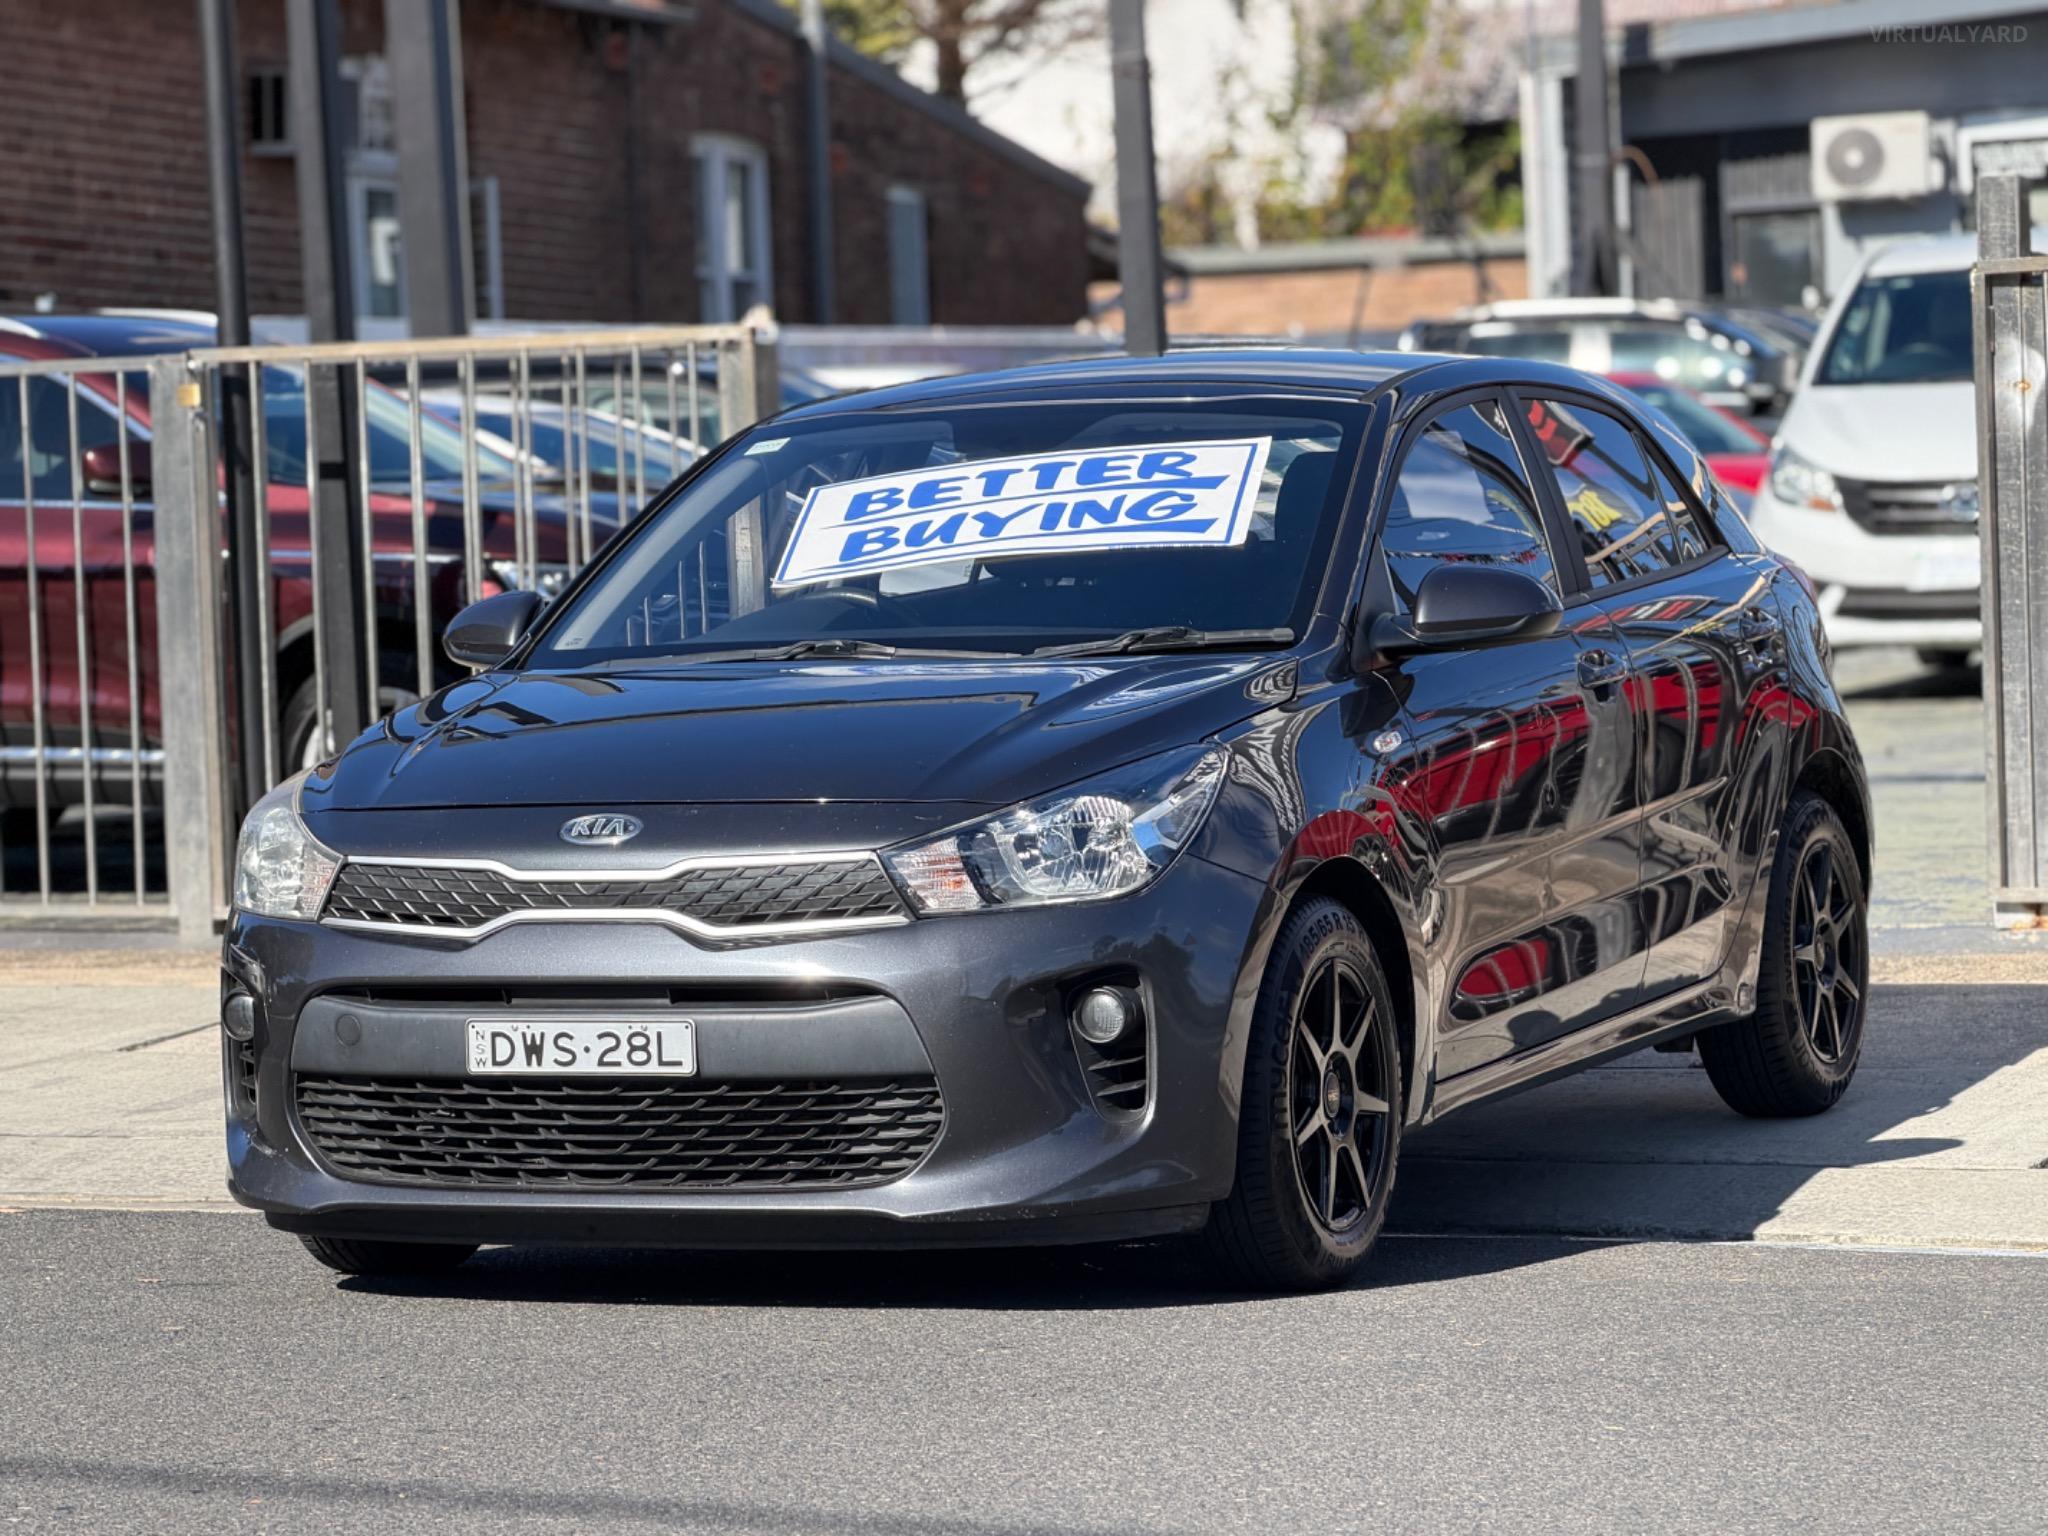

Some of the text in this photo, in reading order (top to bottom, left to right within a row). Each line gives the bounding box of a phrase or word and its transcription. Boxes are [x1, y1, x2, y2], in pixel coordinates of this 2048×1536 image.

[844, 451, 1197, 521] BETTER
[839, 490, 1197, 562] BUYING
[571, 818, 625, 837] KIA
